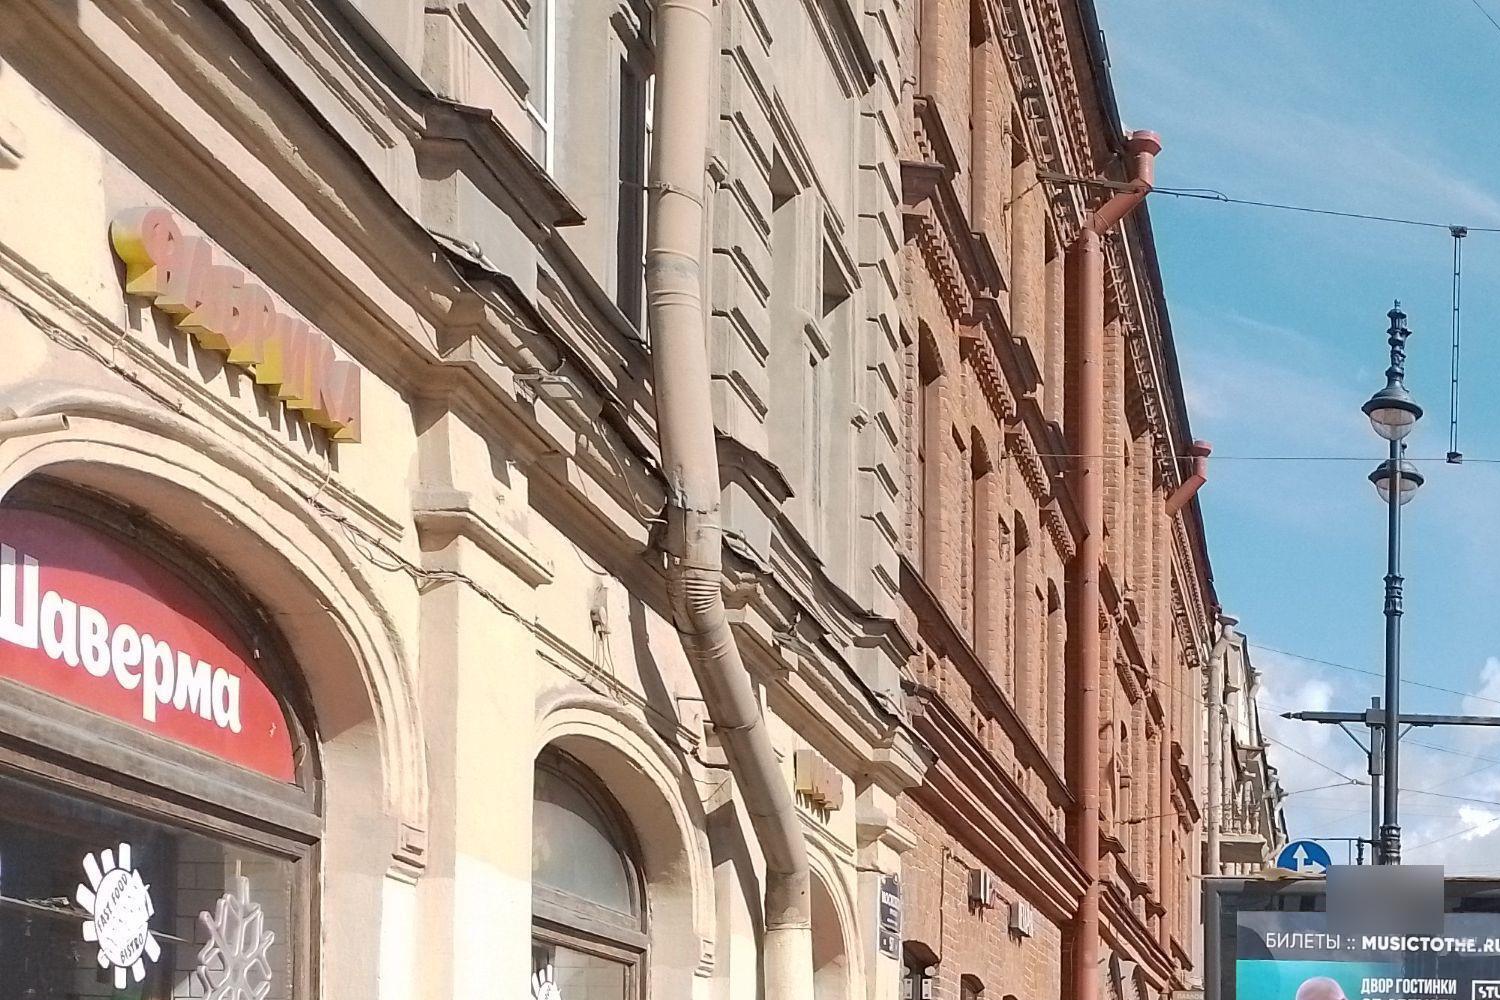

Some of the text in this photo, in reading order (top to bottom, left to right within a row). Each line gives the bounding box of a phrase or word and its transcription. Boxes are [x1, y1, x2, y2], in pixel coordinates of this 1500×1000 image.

[0, 543, 242, 734] Шаверма
[98, 873, 128, 932] FAST FOOD
[119, 933, 144, 965] BISTRO
[1265, 933, 1341, 949] БИЛЕТЫ
[1360, 978, 1457, 995] ДВОР ГОСТИНКИ
